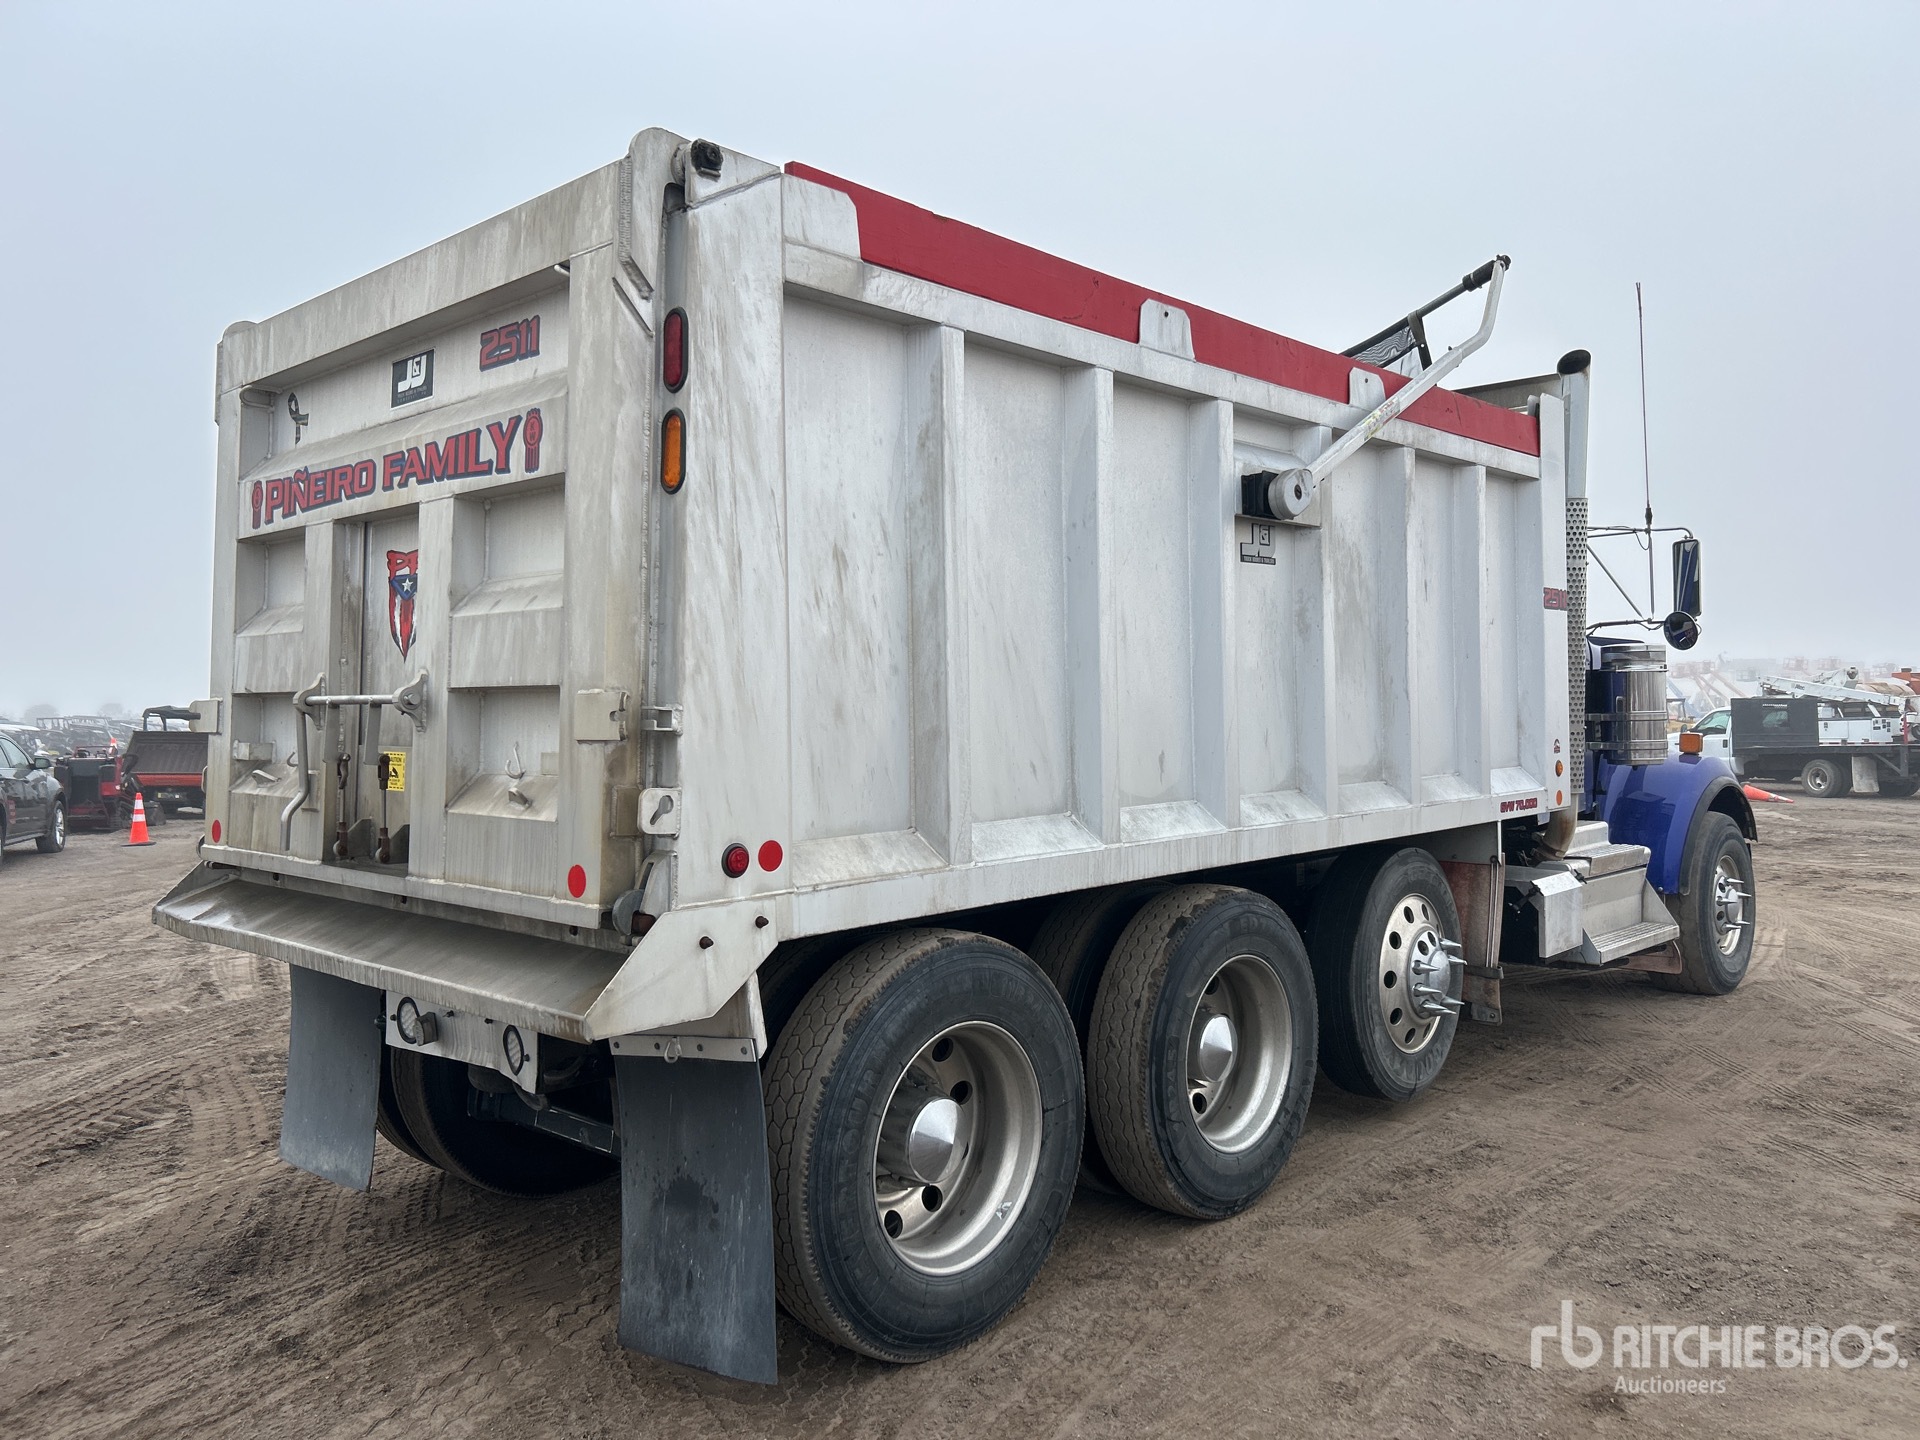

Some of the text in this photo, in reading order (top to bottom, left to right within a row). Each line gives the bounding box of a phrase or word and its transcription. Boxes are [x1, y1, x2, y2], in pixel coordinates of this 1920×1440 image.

[479, 314, 541, 372] 2511
[264, 414, 523, 525] PIÑEIRO FAMILY
[1515, 797, 1538, 811] 70,000
